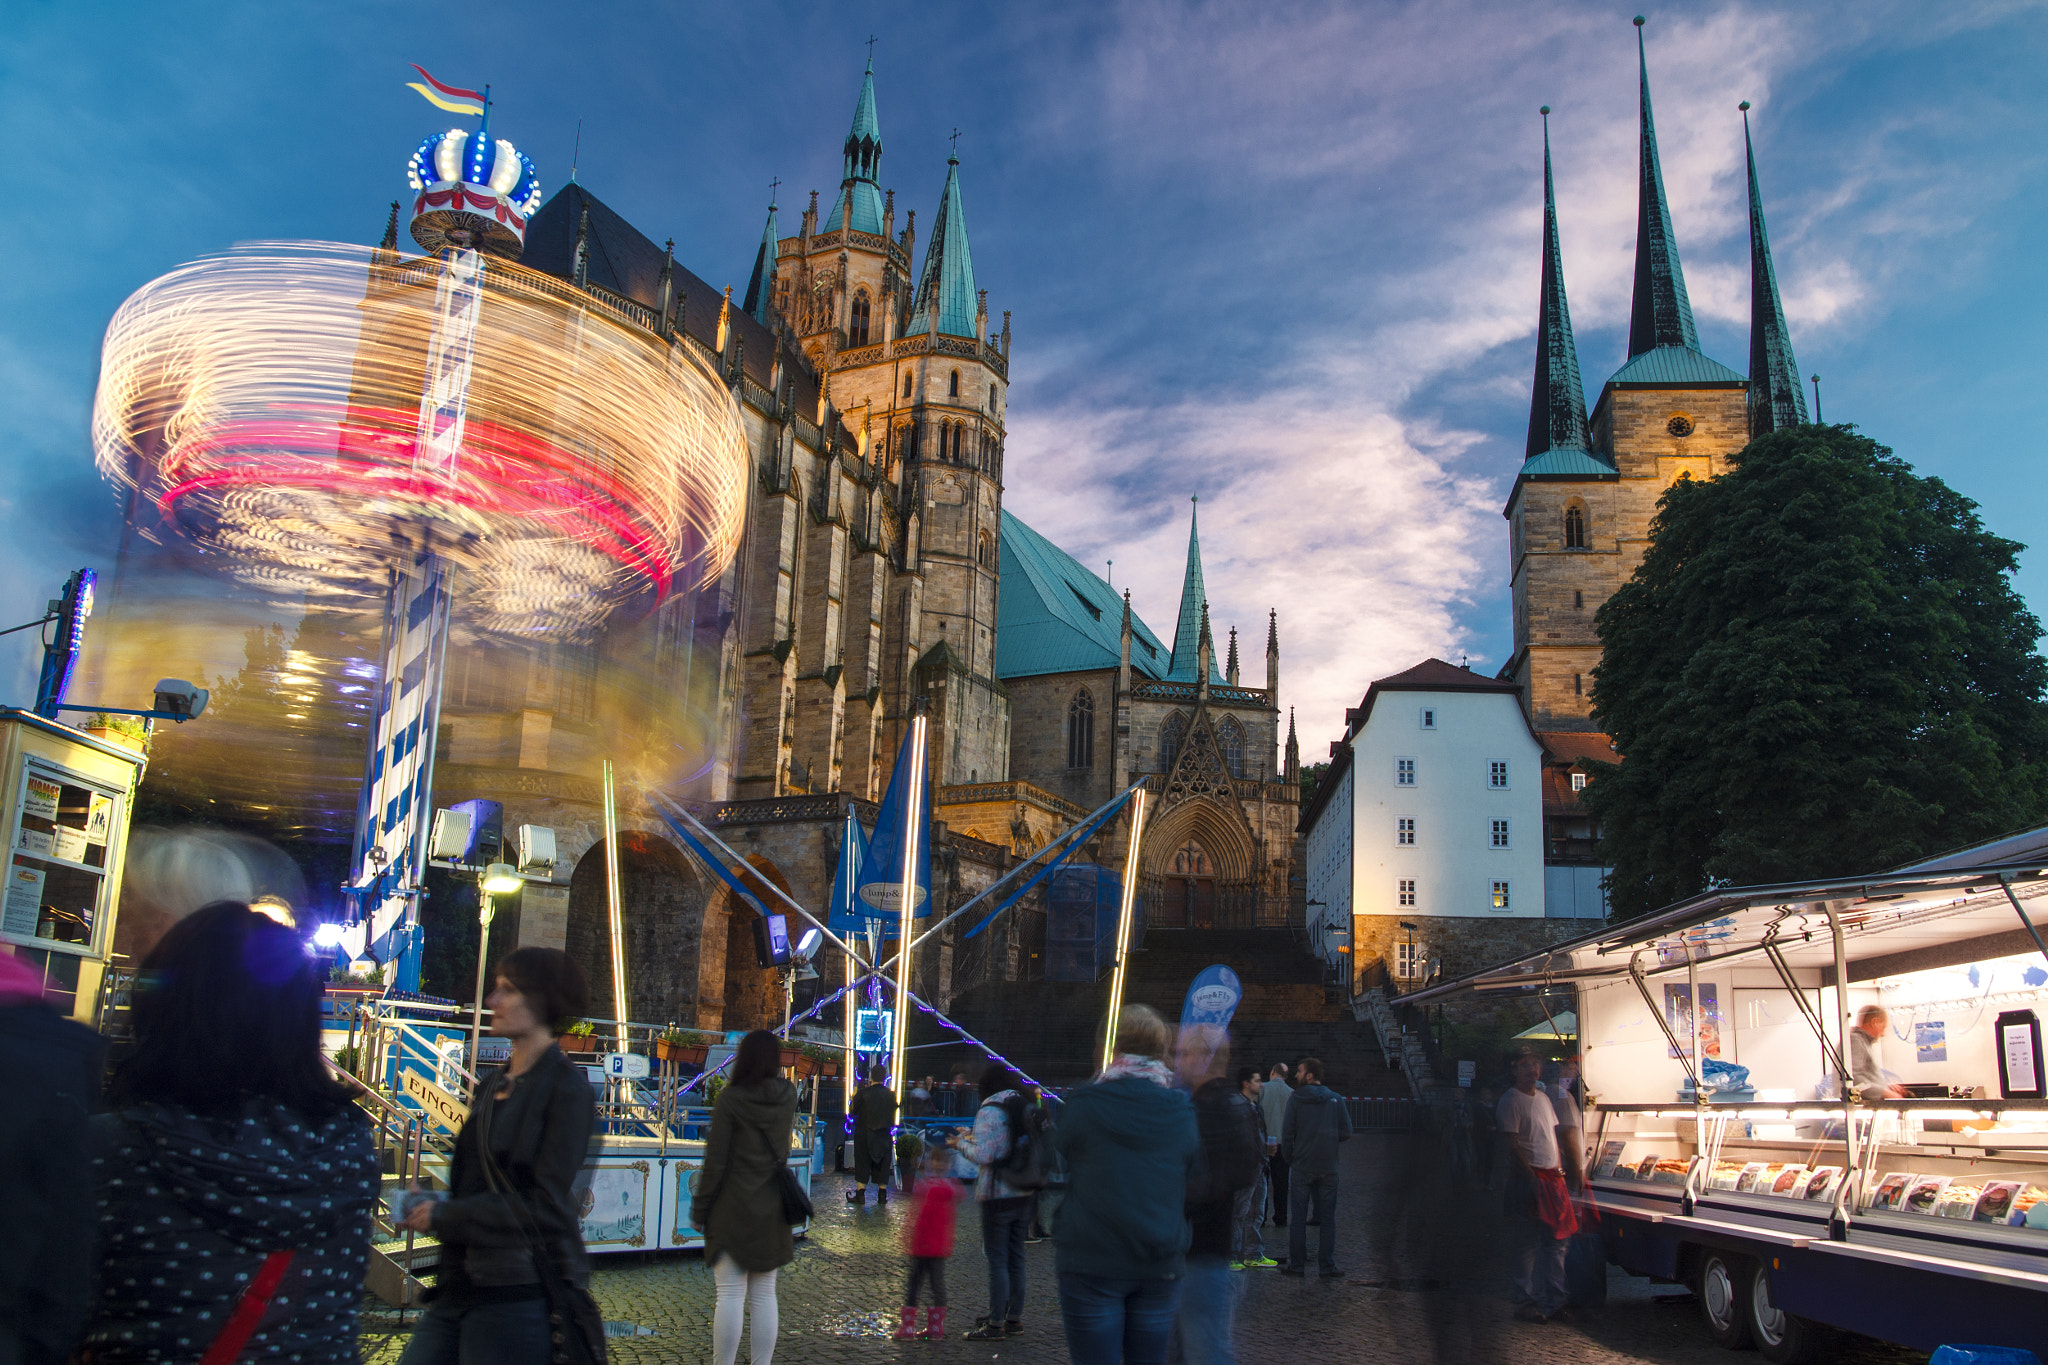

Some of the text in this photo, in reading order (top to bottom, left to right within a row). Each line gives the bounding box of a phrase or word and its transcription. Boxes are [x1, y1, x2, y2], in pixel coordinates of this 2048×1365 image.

[868, 889, 904, 899] Jump&
[614, 1060, 622, 1071] P
[410, 1077, 464, 1126] EINGA
